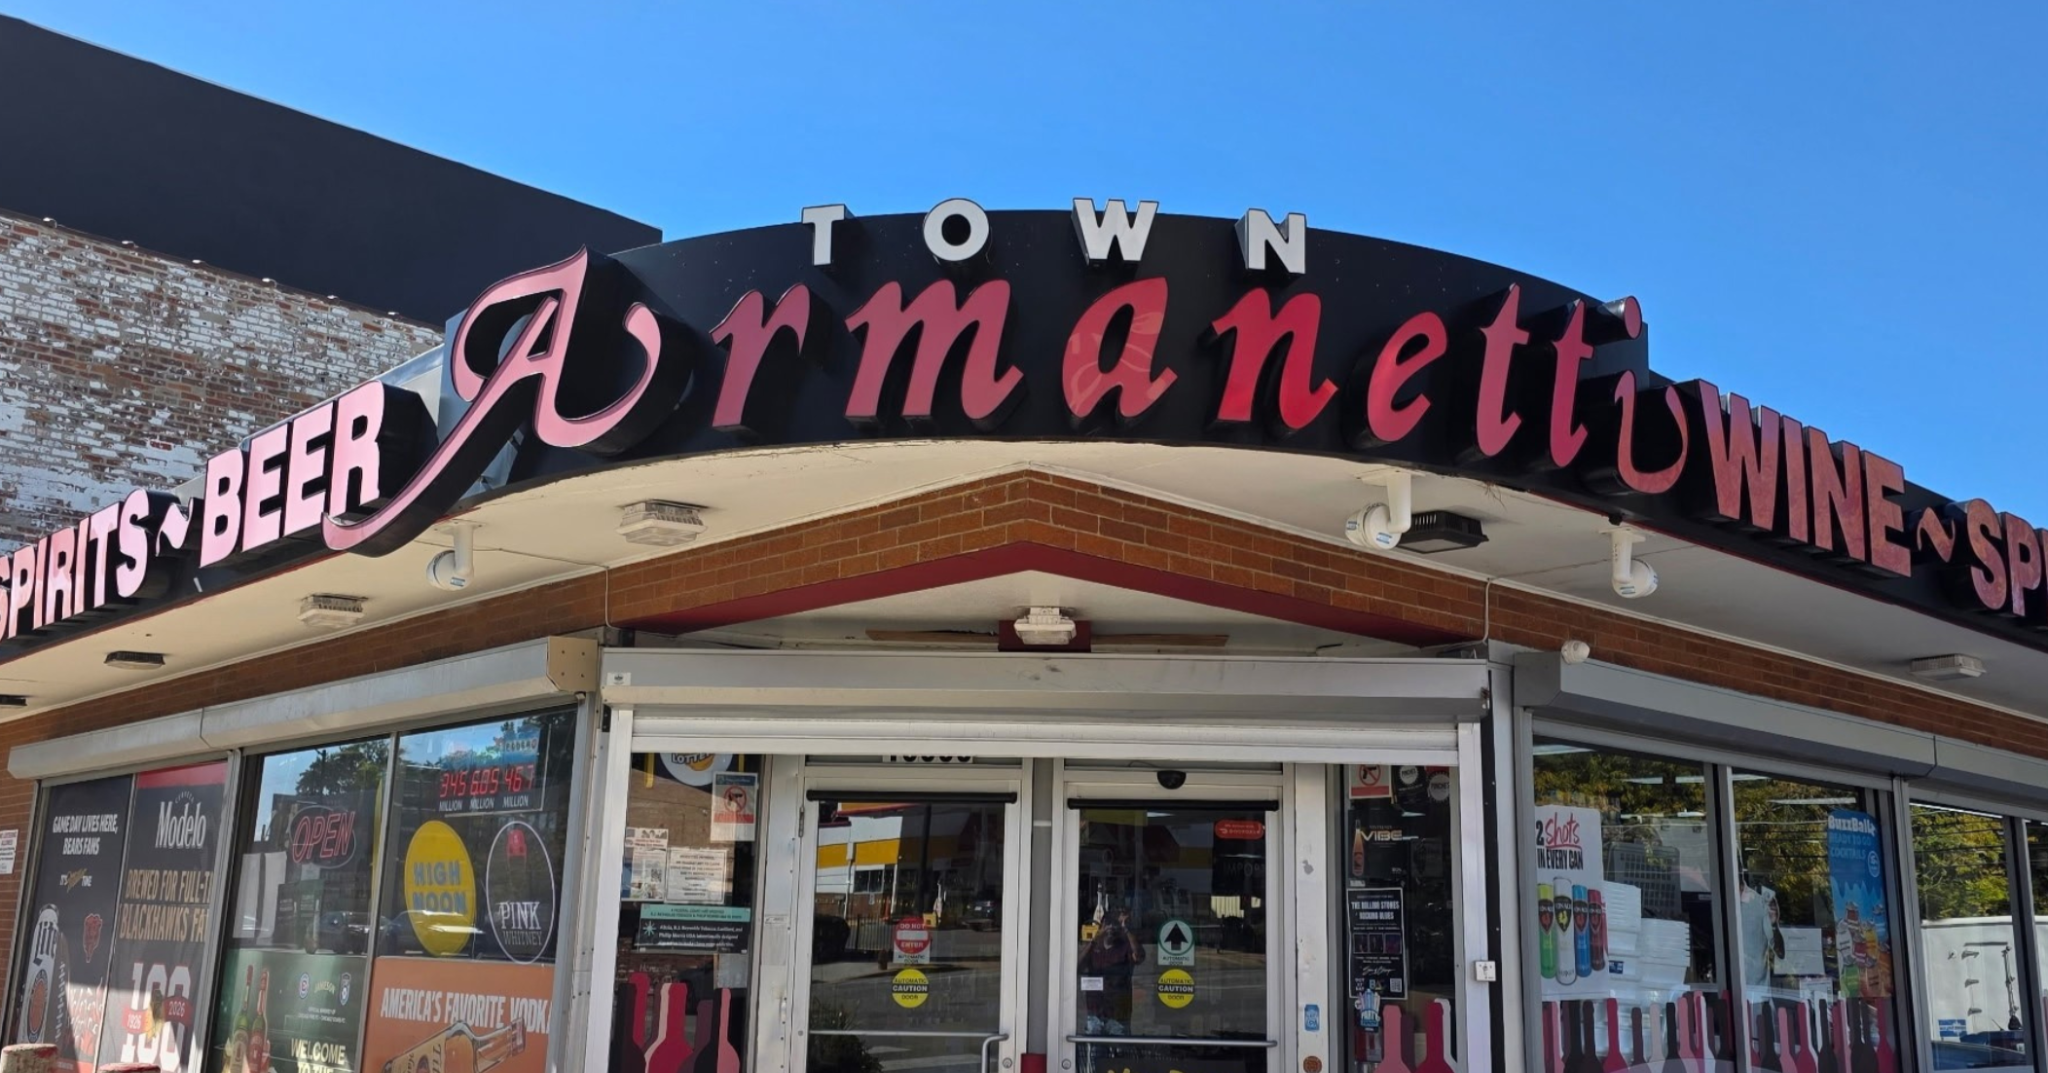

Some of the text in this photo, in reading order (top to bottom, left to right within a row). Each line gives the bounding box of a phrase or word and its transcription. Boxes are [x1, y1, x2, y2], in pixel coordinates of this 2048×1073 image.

[802, 197, 1306, 275] TOWN
[320, 244, 1688, 551] Armanetti
[200, 380, 385, 569] BEER
[1698, 378, 1911, 578] WINE
[440, 771, 468, 798] 345
[504, 764, 535, 792] 467
[439, 795, 529, 812] MILLION MILLION MILLION
[52, 816, 69, 833] GAME
[69, 815, 82, 832] DAY
[82, 814, 100, 832] LIVES
[155, 801, 206, 849] Modelo
[292, 811, 356, 863] OPEN
[1360, 830, 1402, 841] VIBE
[1536, 820, 1544, 846] 2
[62, 837, 100, 855] BEARS FANS
[1830, 846, 1866, 860] COCKTAILS
[1852, 834, 1861, 846] TO
[1862, 836, 1872, 847] GO
[1537, 848, 1583, 870] IN EVERY CAN
[126, 869, 160, 900] BREWED
[160, 870, 178, 901] FOR
[414, 860, 461, 886] HIGH
[412, 891, 467, 914] NOON
[500, 901, 541, 930] PINK
[120, 903, 190, 942] BLACKHAWKS
[503, 930, 542, 946] WHITNEY
[168, 1001, 185, 1017] 2026
[380, 987, 442, 1023] AMERICA'S
[444, 992, 506, 1030] FAVORITE
[291, 1038, 346, 1066] WELCOME
